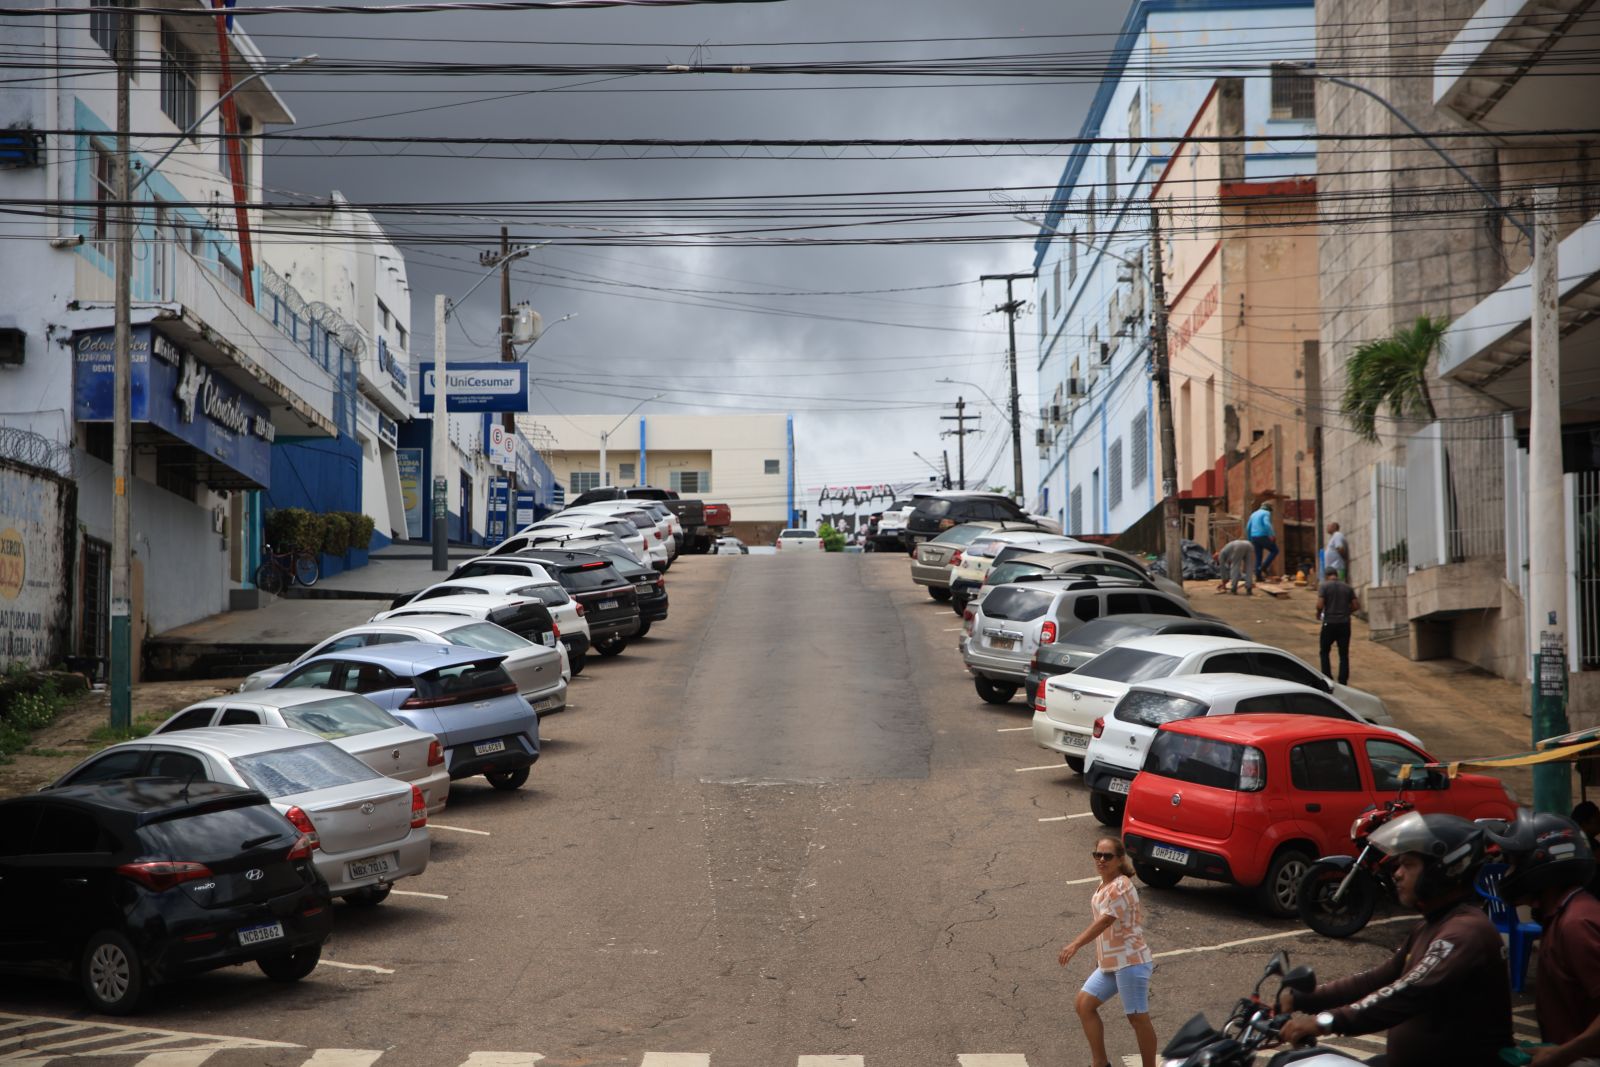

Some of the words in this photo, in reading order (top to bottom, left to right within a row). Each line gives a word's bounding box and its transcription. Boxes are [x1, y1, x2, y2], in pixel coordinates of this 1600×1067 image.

[450, 375, 514, 387] UniCesumar
[0, 538, 21, 557] XEROX
[243, 926, 281, 944] NCB1B62
